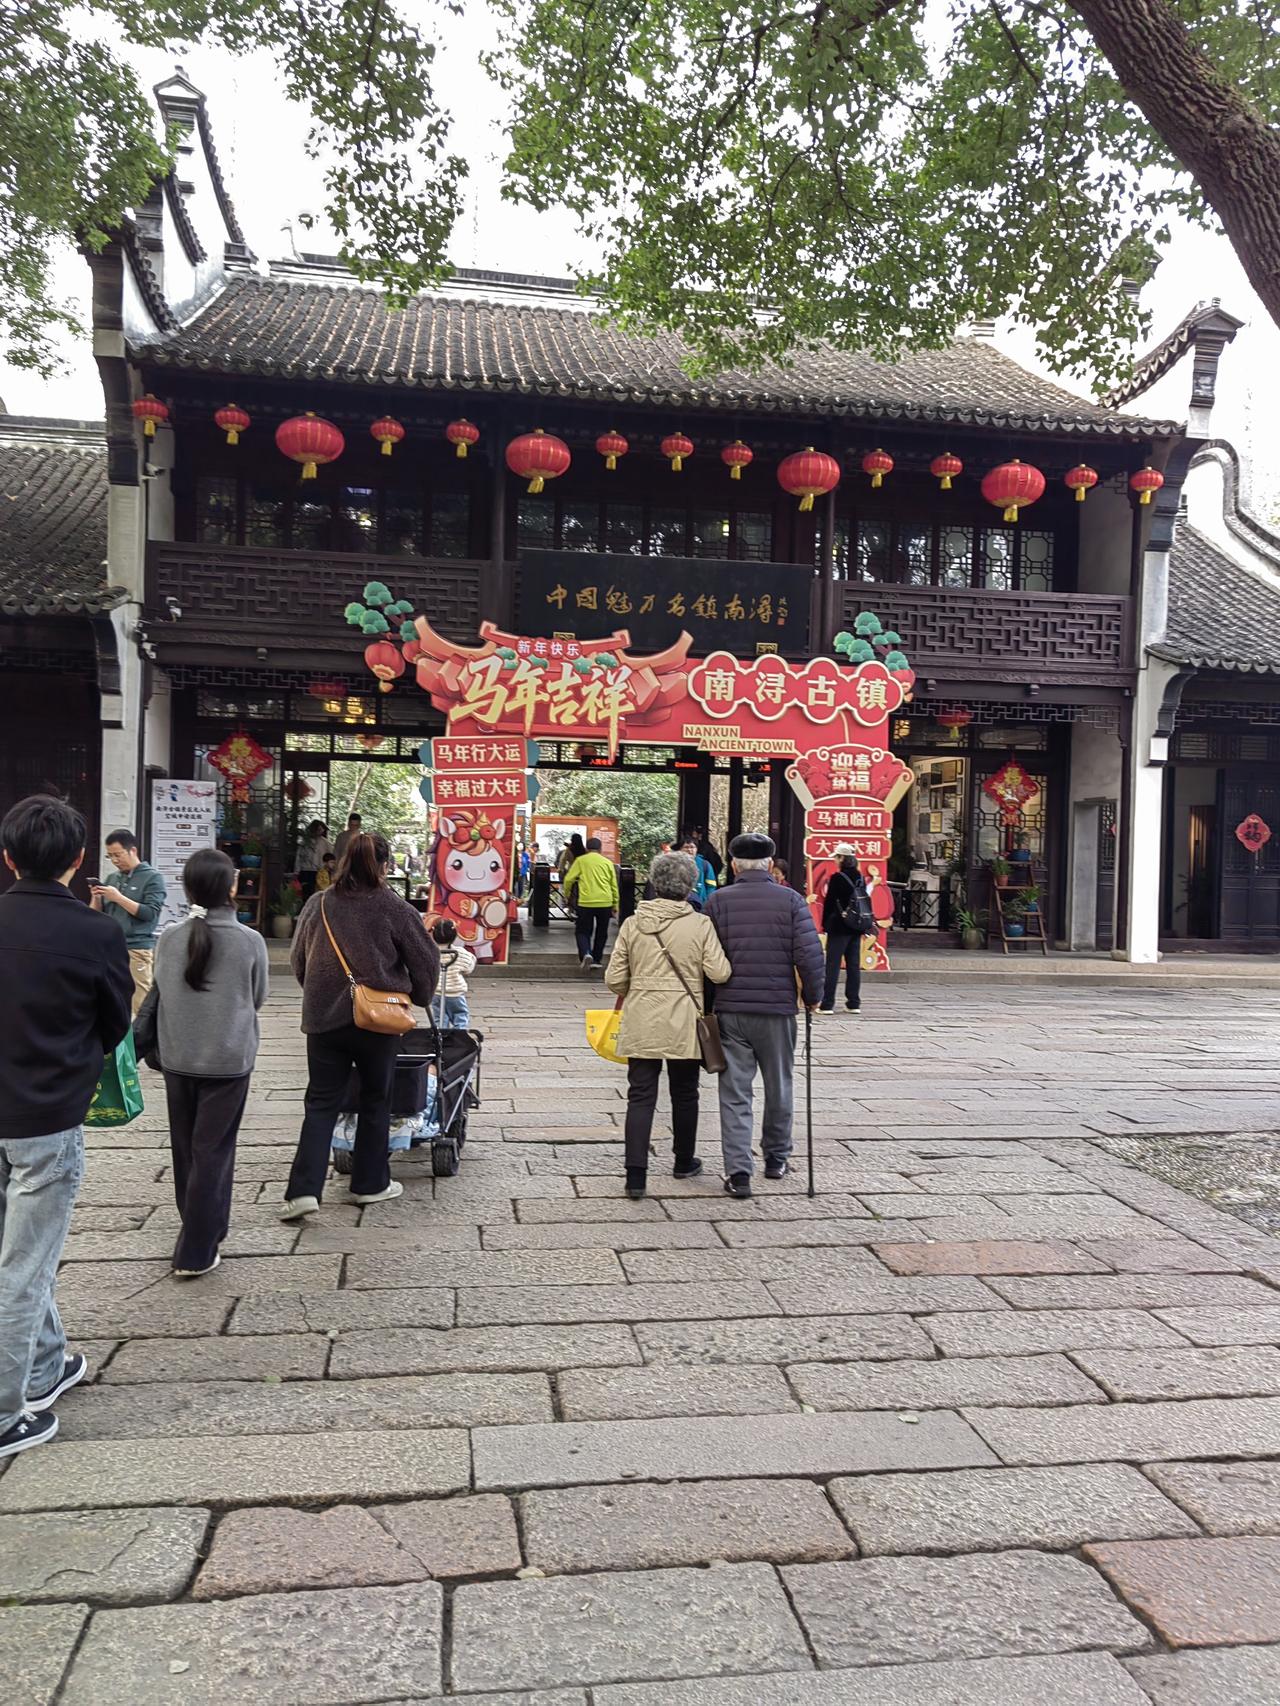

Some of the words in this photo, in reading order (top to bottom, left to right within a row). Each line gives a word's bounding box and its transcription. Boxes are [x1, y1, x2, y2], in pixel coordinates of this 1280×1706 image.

[517, 640, 581, 657] 新年快乐
[704, 668, 889, 710] 南浔古镇
[451, 655, 635, 764] 马年吉祥
[685, 726, 739, 737] NANXUN
[437, 744, 521, 764] 马年行大运
[700, 739, 753, 750] ANCIENT
[756, 741, 793, 751] TOWN
[830, 752, 872, 770] 迎春
[437, 778, 521, 798] 幸福过大年
[817, 811, 882, 828] 马福临门
